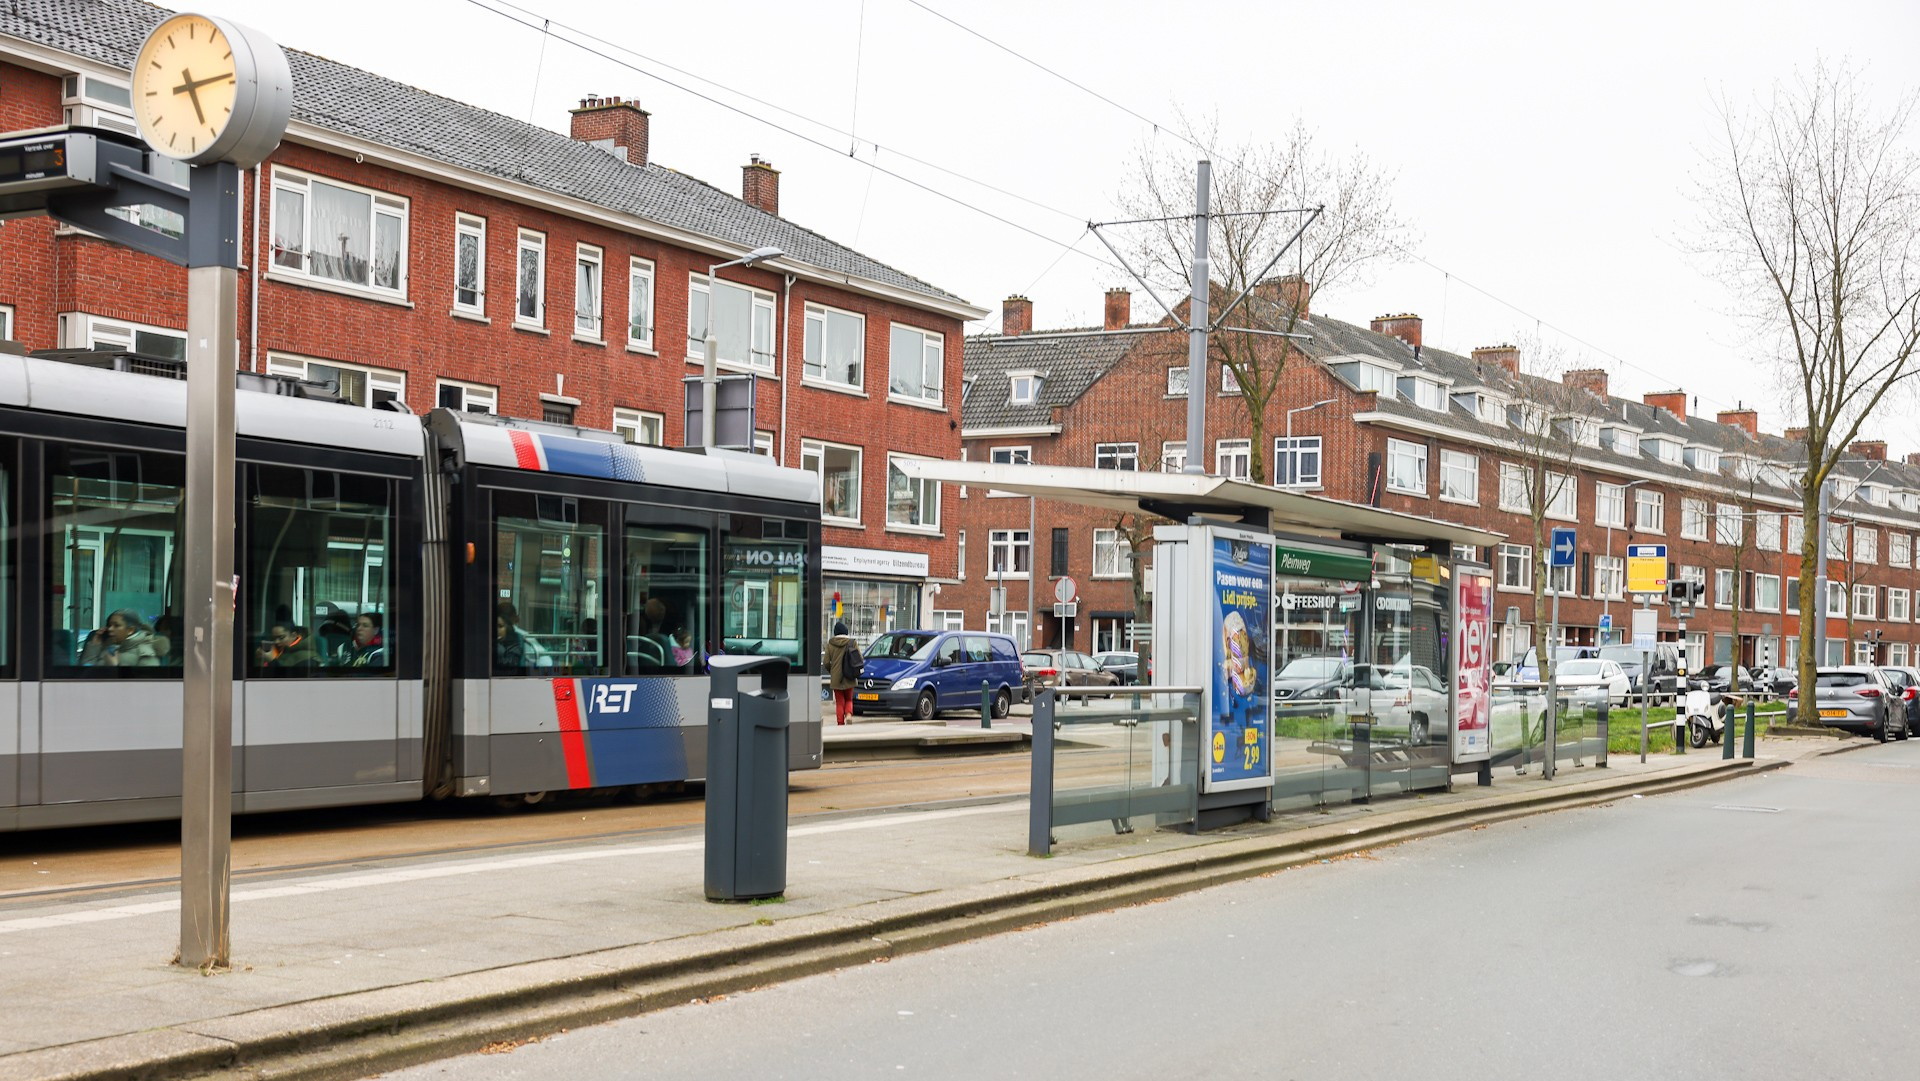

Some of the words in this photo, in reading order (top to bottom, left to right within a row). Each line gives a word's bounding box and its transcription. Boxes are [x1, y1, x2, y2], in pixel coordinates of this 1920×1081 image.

[54, 149, 64, 166] 3
[1281, 553, 1312, 575] Pleinweg
[1216, 570, 1237, 586] Pasen
[1237, 575, 1252, 588] voor
[1251, 578, 1263, 589] een
[1222, 589, 1236, 605] Lidl
[1236, 591, 1258, 609] prijsje.
[589, 684, 638, 713] RET
[1244, 746, 1260, 770] 2.99
